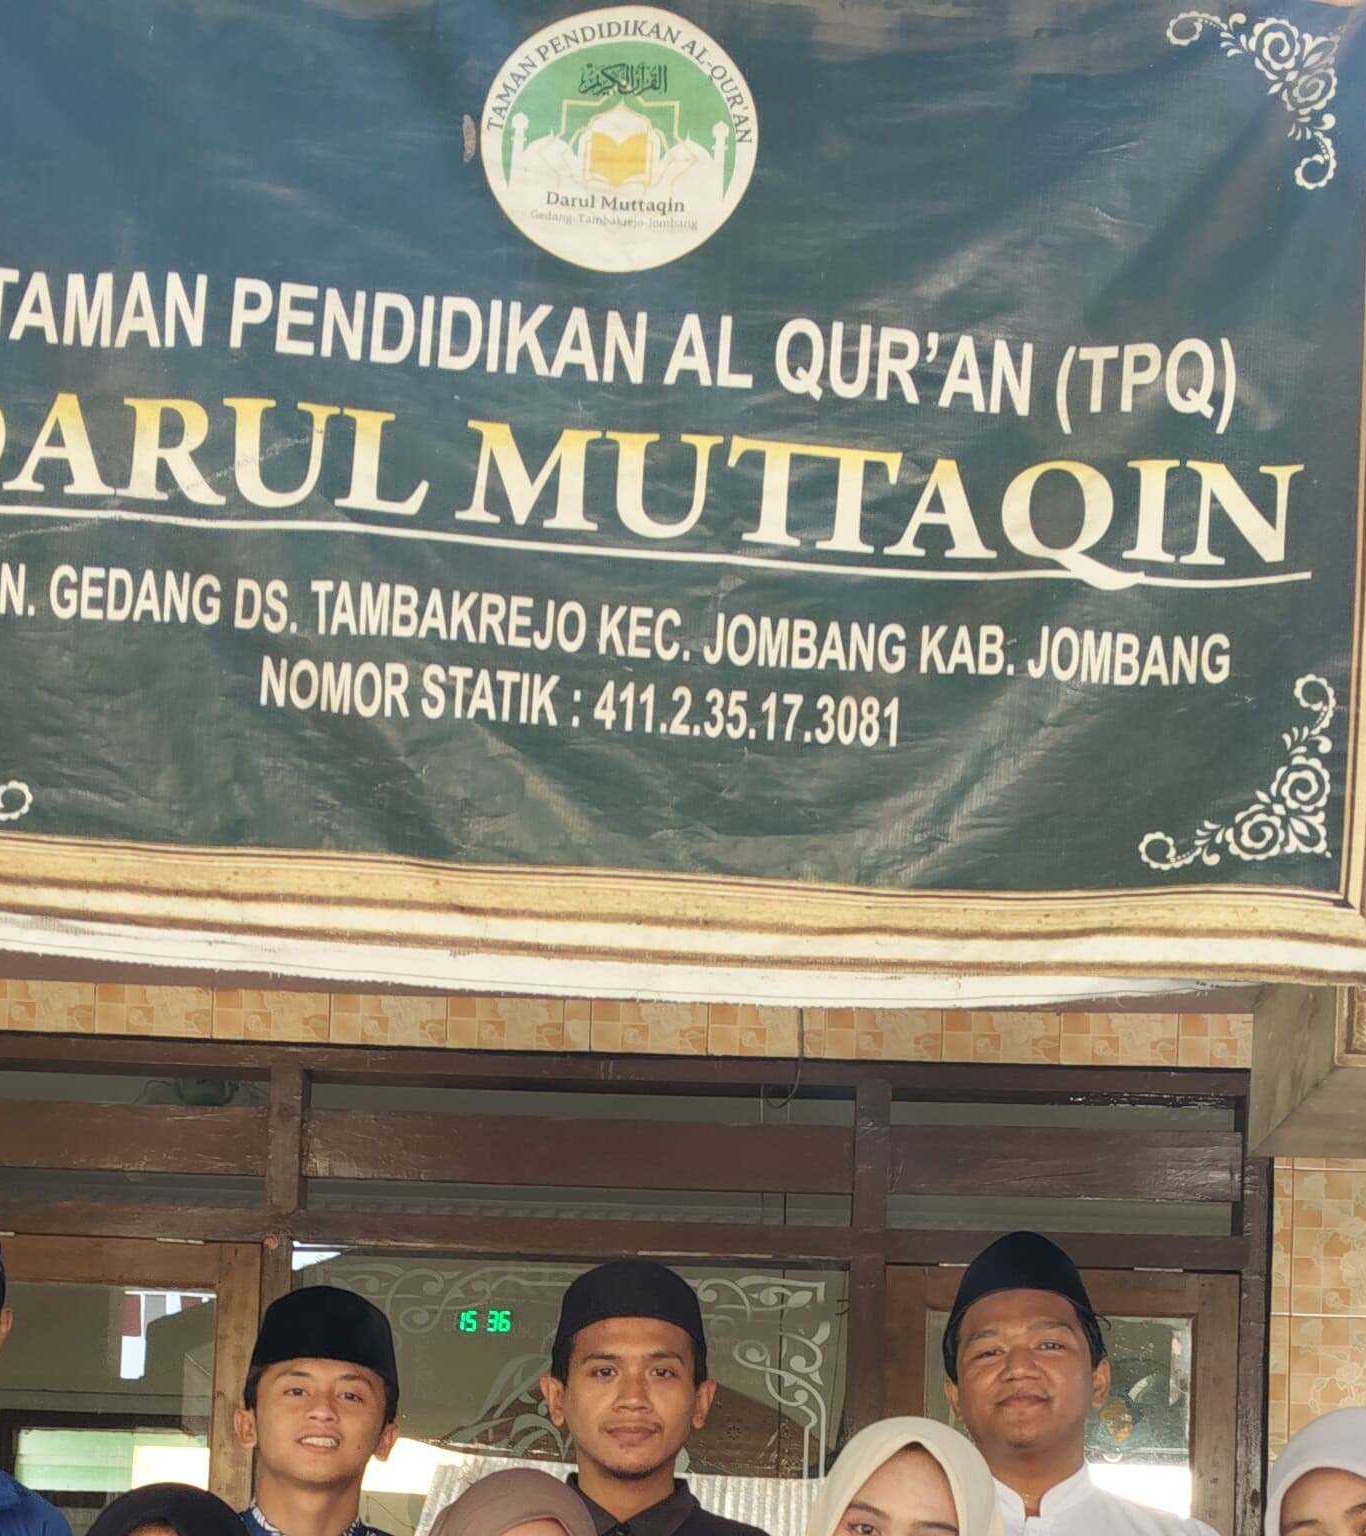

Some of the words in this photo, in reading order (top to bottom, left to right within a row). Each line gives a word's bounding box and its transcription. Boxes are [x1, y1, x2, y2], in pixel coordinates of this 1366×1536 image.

[487, 56, 540, 131] TAMAN
[536, 19, 682, 64] PENDIDIKAN
[546, 191, 595, 209] Darul
[601, 195, 685, 216] Muttaqin
[229, 276, 648, 386] PENDIDIKAN
[663, 313, 754, 389] AL
[775, 317, 1034, 417] QUR'AN
[1055, 336, 1237, 435] (TPQ)
[454, 419, 1305, 591] MUTTAQIN
[49, 564, 222, 626] GEDANG
[234, 577, 298, 635] DS.
[311, 580, 587, 654] TAMBAKREJO
[597, 604, 691, 662] KEC.
[703, 611, 908, 674] JOMBANG
[919, 623, 1015, 676] KAB.
[1027, 624, 1232, 687] JOMBANG
[259, 656, 410, 718] NOMOR
[420, 664, 559, 727] STATIK
[593, 679, 900, 748] 411.2.35.17.3081
